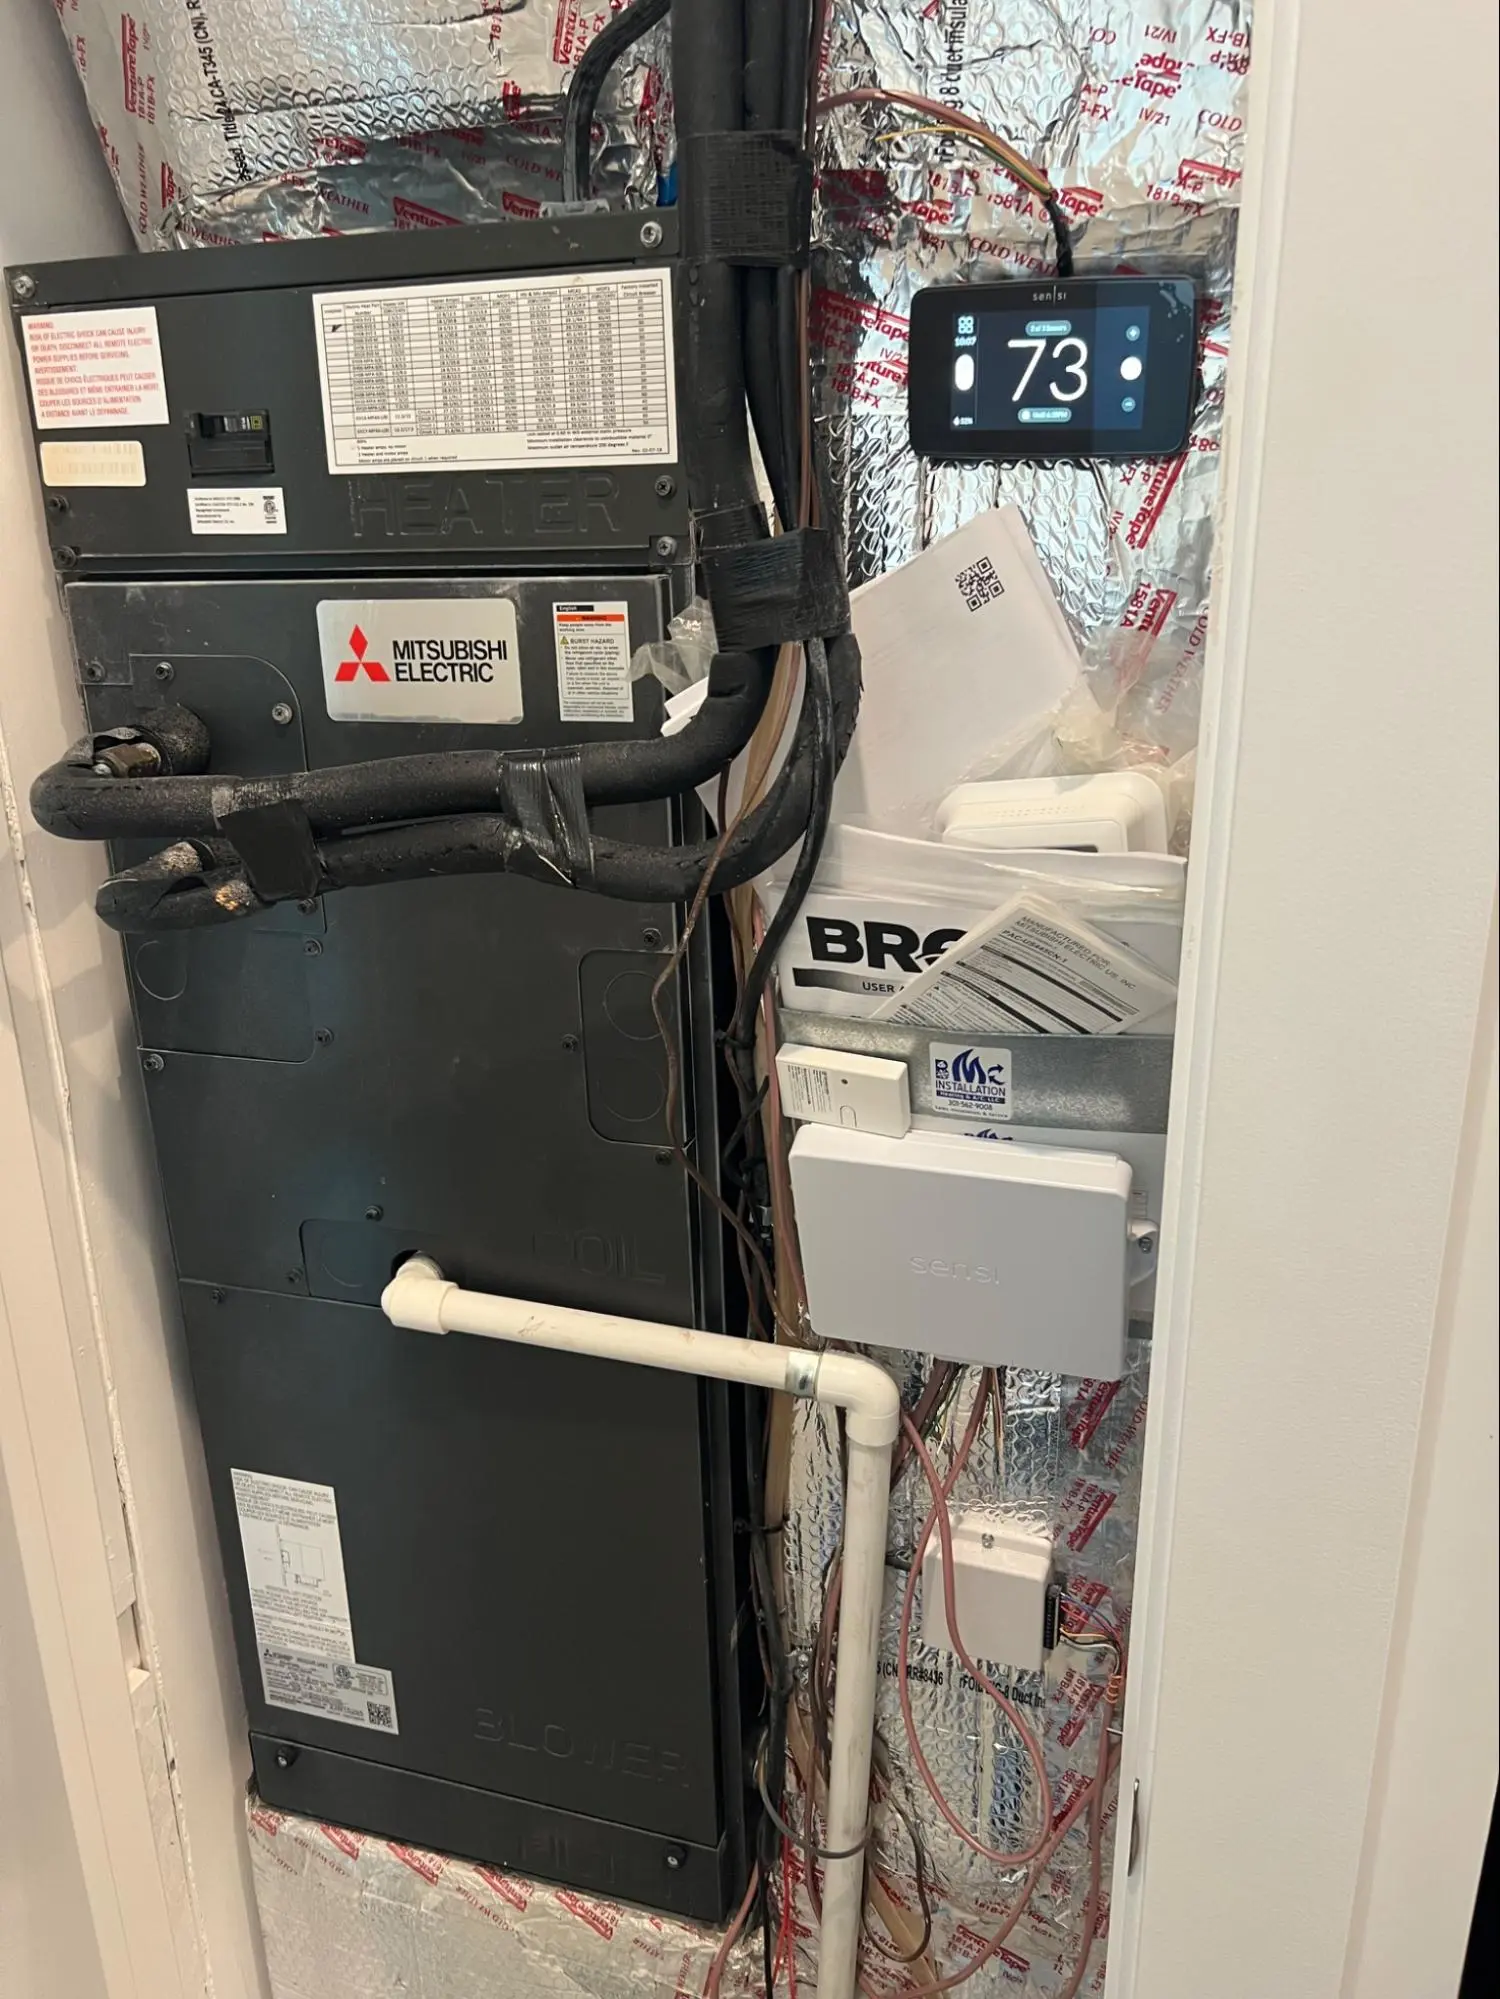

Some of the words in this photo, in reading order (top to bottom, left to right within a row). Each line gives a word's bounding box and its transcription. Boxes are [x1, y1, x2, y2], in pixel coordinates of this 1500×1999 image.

[199, 49, 225, 99] CA-T345
[1138, 108, 1170, 126] IV/21
[1198, 109, 1242, 131] COLD
[970, 236, 1011, 260] COLD
[1007, 337, 1088, 402] 73
[349, 470, 621, 537] HEATER
[1121, 582, 1152, 628] 1581A
[392, 639, 507, 661] MITSUBISHI
[394, 662, 494, 683] ELECTRIC
[1021, 916, 1096, 957] MANUFACTURED
[1064, 942, 1106, 972] ELECTRIC
[862, 981, 895, 993] USER
[936, 1080, 1006, 1097] INSTALLATION
